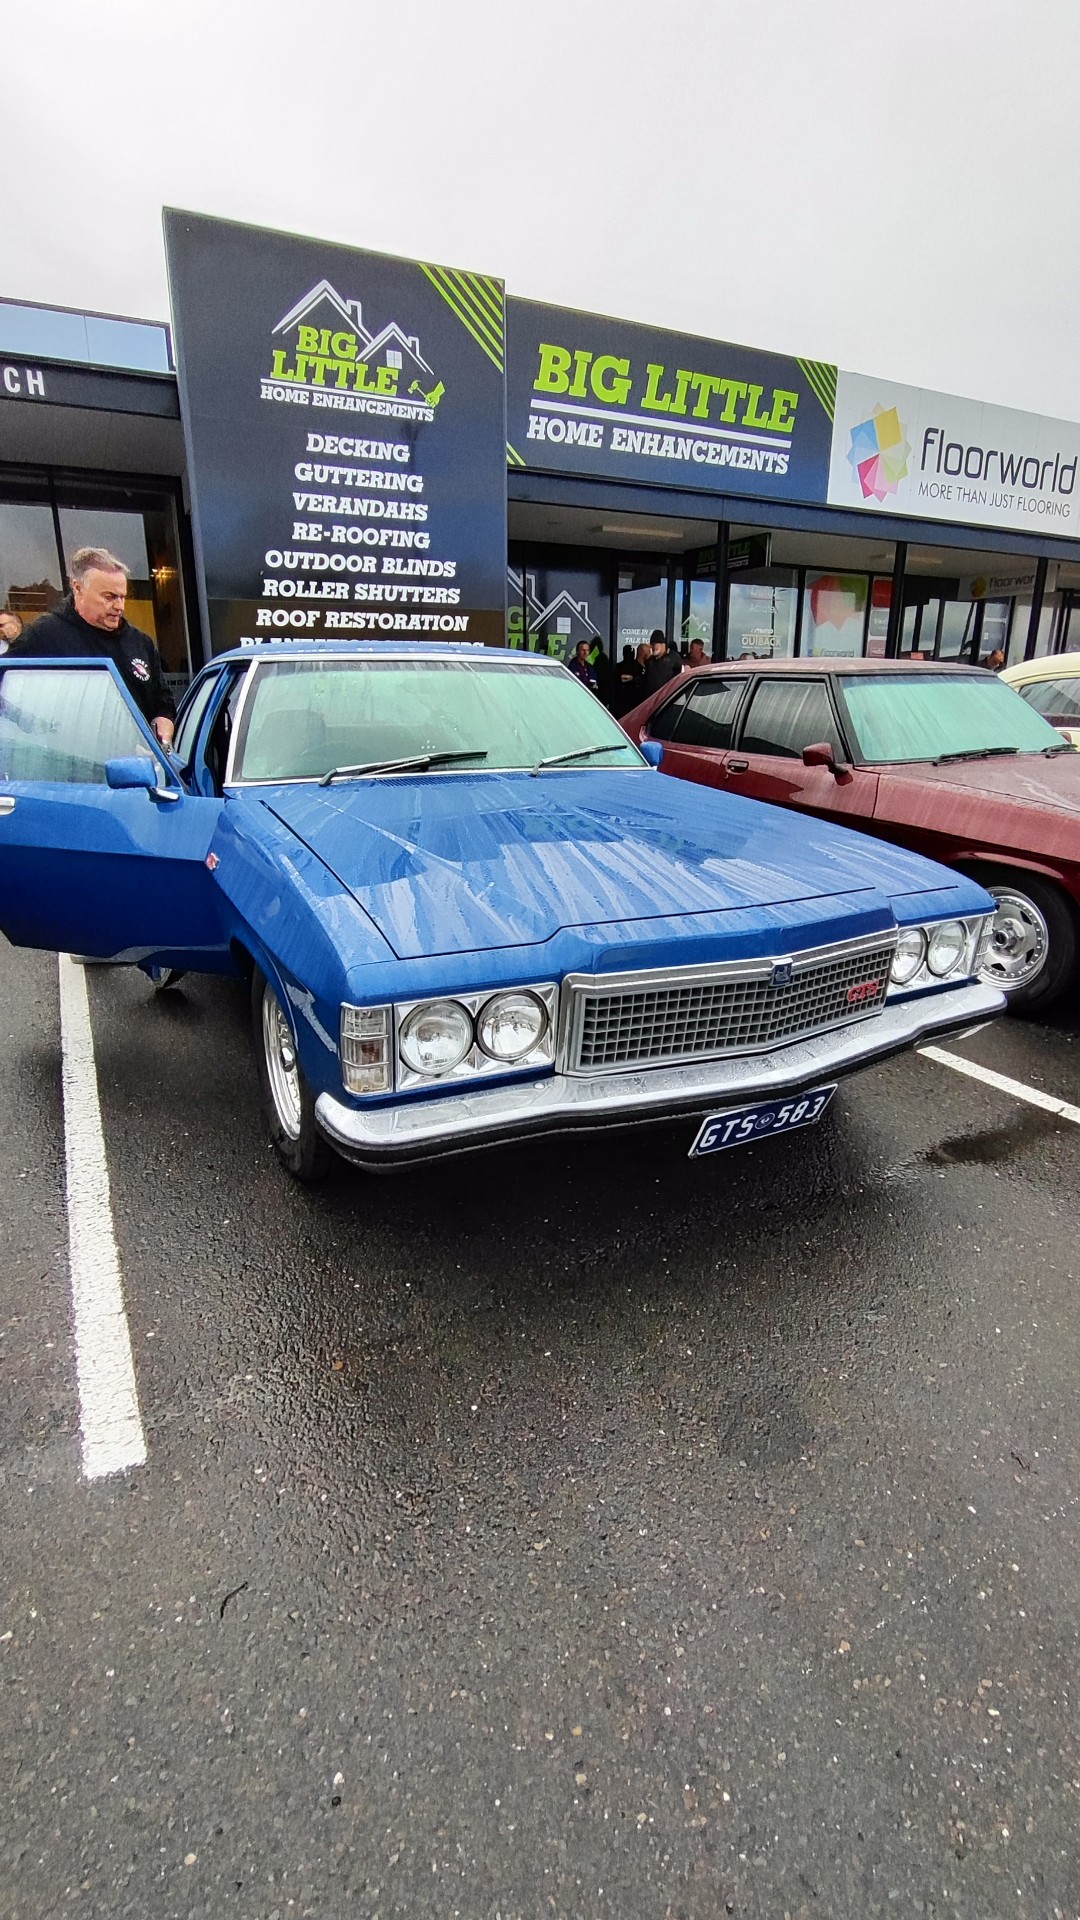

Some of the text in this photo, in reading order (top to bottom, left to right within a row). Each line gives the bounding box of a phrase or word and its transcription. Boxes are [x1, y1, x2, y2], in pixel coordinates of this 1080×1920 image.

[296, 325, 358, 360] BIG
[3, 366, 45, 396] CH
[270, 349, 399, 396] LITTLE
[533, 343, 799, 433] BIG LITTLE
[260, 385, 435, 422] HOME ENHANCEMENTS
[306, 433, 410, 462] DECKING
[526, 415, 790, 475] HOME ENHANCEMENTS
[920, 427, 1079, 495] floorworld
[294, 463, 424, 492] GUTTERING
[293, 492, 429, 521] VERANDAHS
[918, 481, 1071, 518] MORE THAN JUST FLOORING
[291, 522, 431, 549] RE-ROOFING
[265, 550, 457, 578] OUTDOOR BLINDS
[262, 579, 460, 604] ROLLER SHUTTERS
[989, 574, 1035, 588] floorwor
[256, 609, 469, 631] ROOF RESTORATION
[847, 979, 880, 1002] GTS
[699, 1096, 826, 1148] GTS 583
